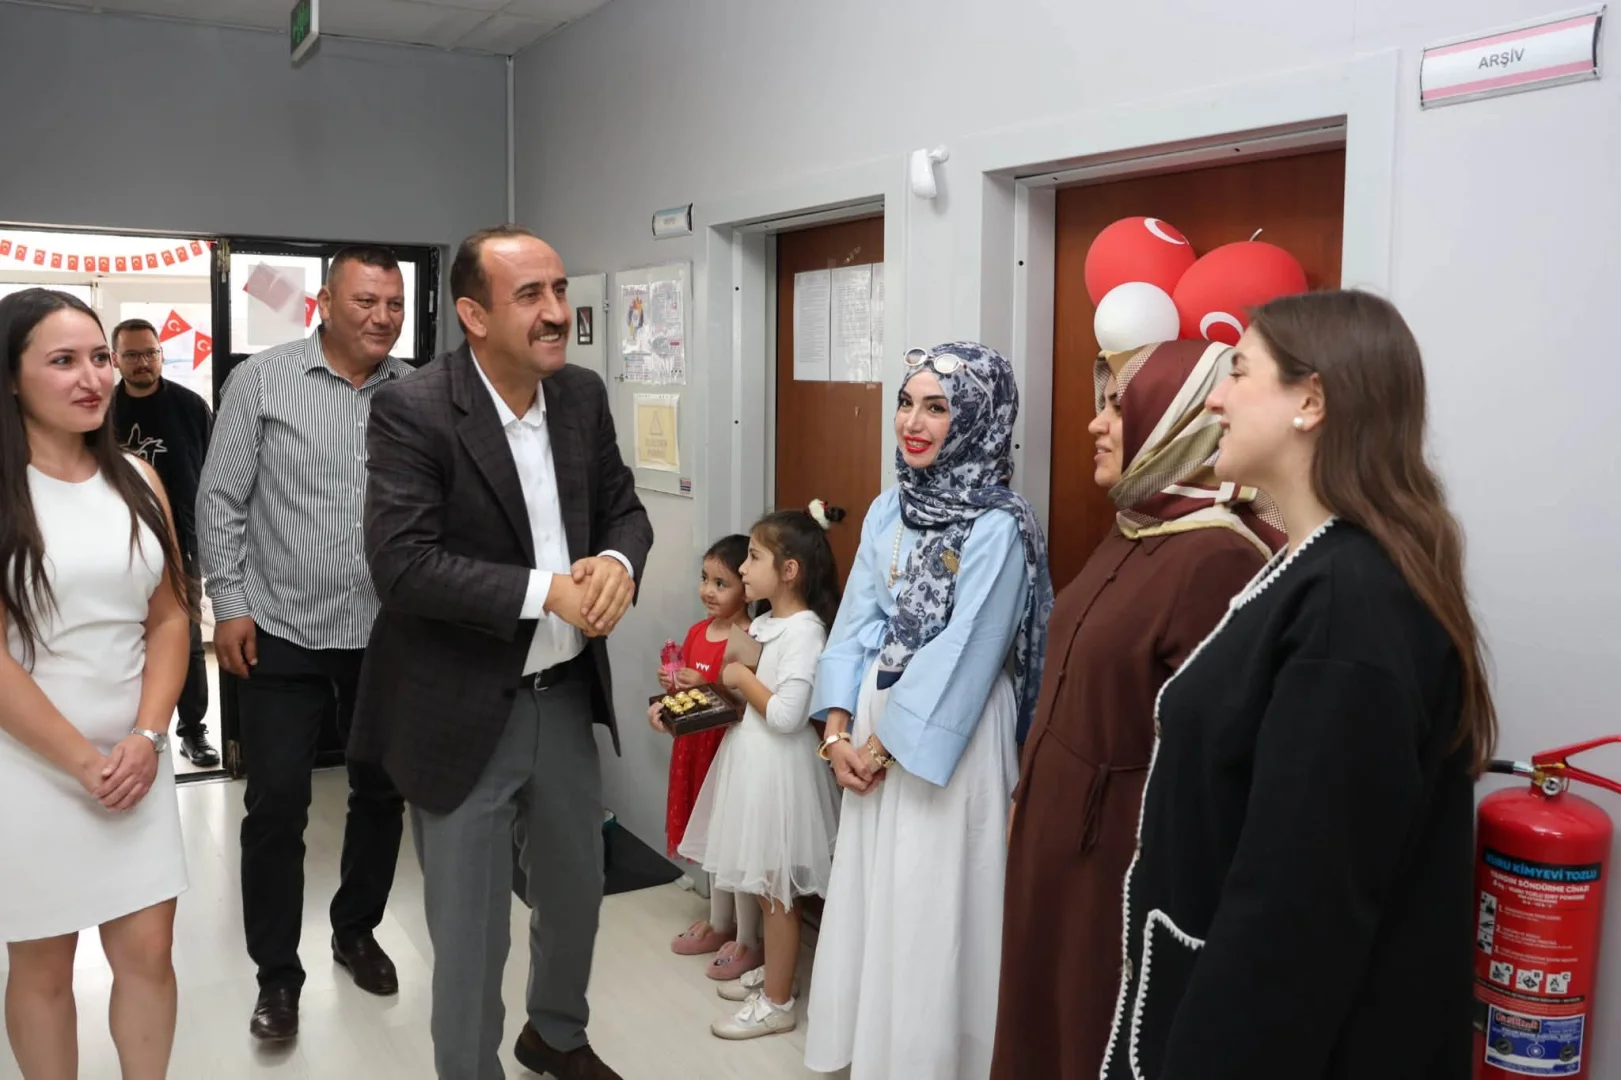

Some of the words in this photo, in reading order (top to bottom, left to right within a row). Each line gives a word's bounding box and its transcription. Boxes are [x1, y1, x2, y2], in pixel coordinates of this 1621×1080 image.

[1478, 48, 1525, 69] ARŞİV
[1512, 862, 1563, 881] KİMYEVİ
[1566, 870, 1597, 881] TOZLU
[1518, 878, 1564, 894] SÖNDÜRME
[1533, 971, 1540, 979] B
[1562, 973, 1570, 981] C
